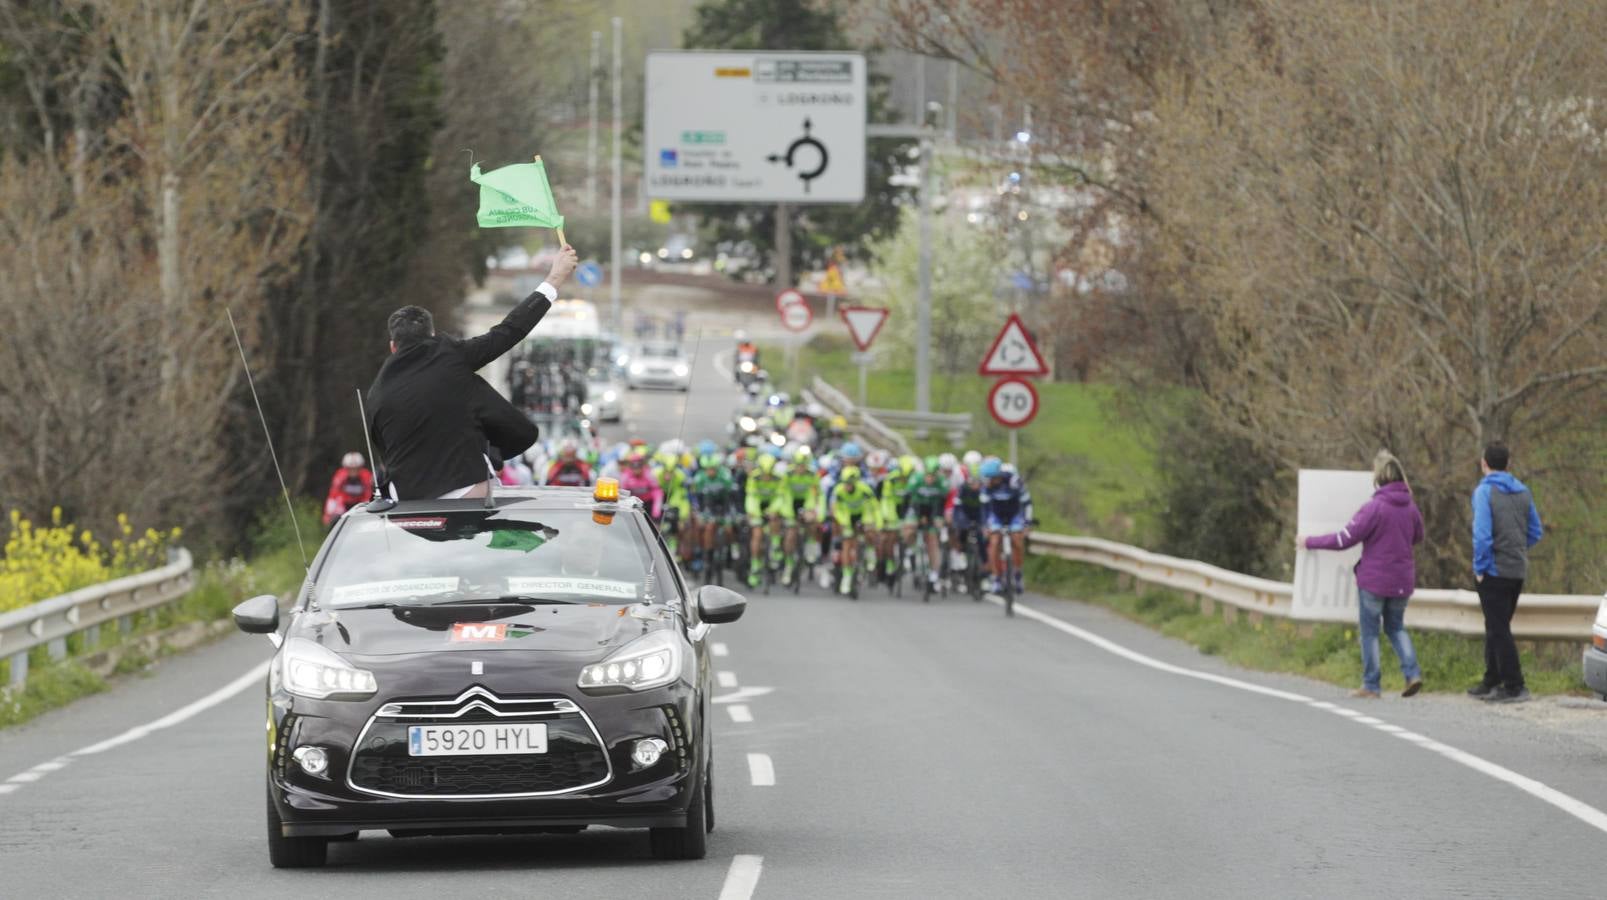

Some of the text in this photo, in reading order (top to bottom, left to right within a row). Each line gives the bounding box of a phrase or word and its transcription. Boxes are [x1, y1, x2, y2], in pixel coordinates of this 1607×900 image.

[1001, 392, 1028, 411] 70
[521, 581, 625, 594] DIRECTOR GENERAL
[461, 625, 497, 638] M
[427, 728, 539, 751] 5920 HYL
